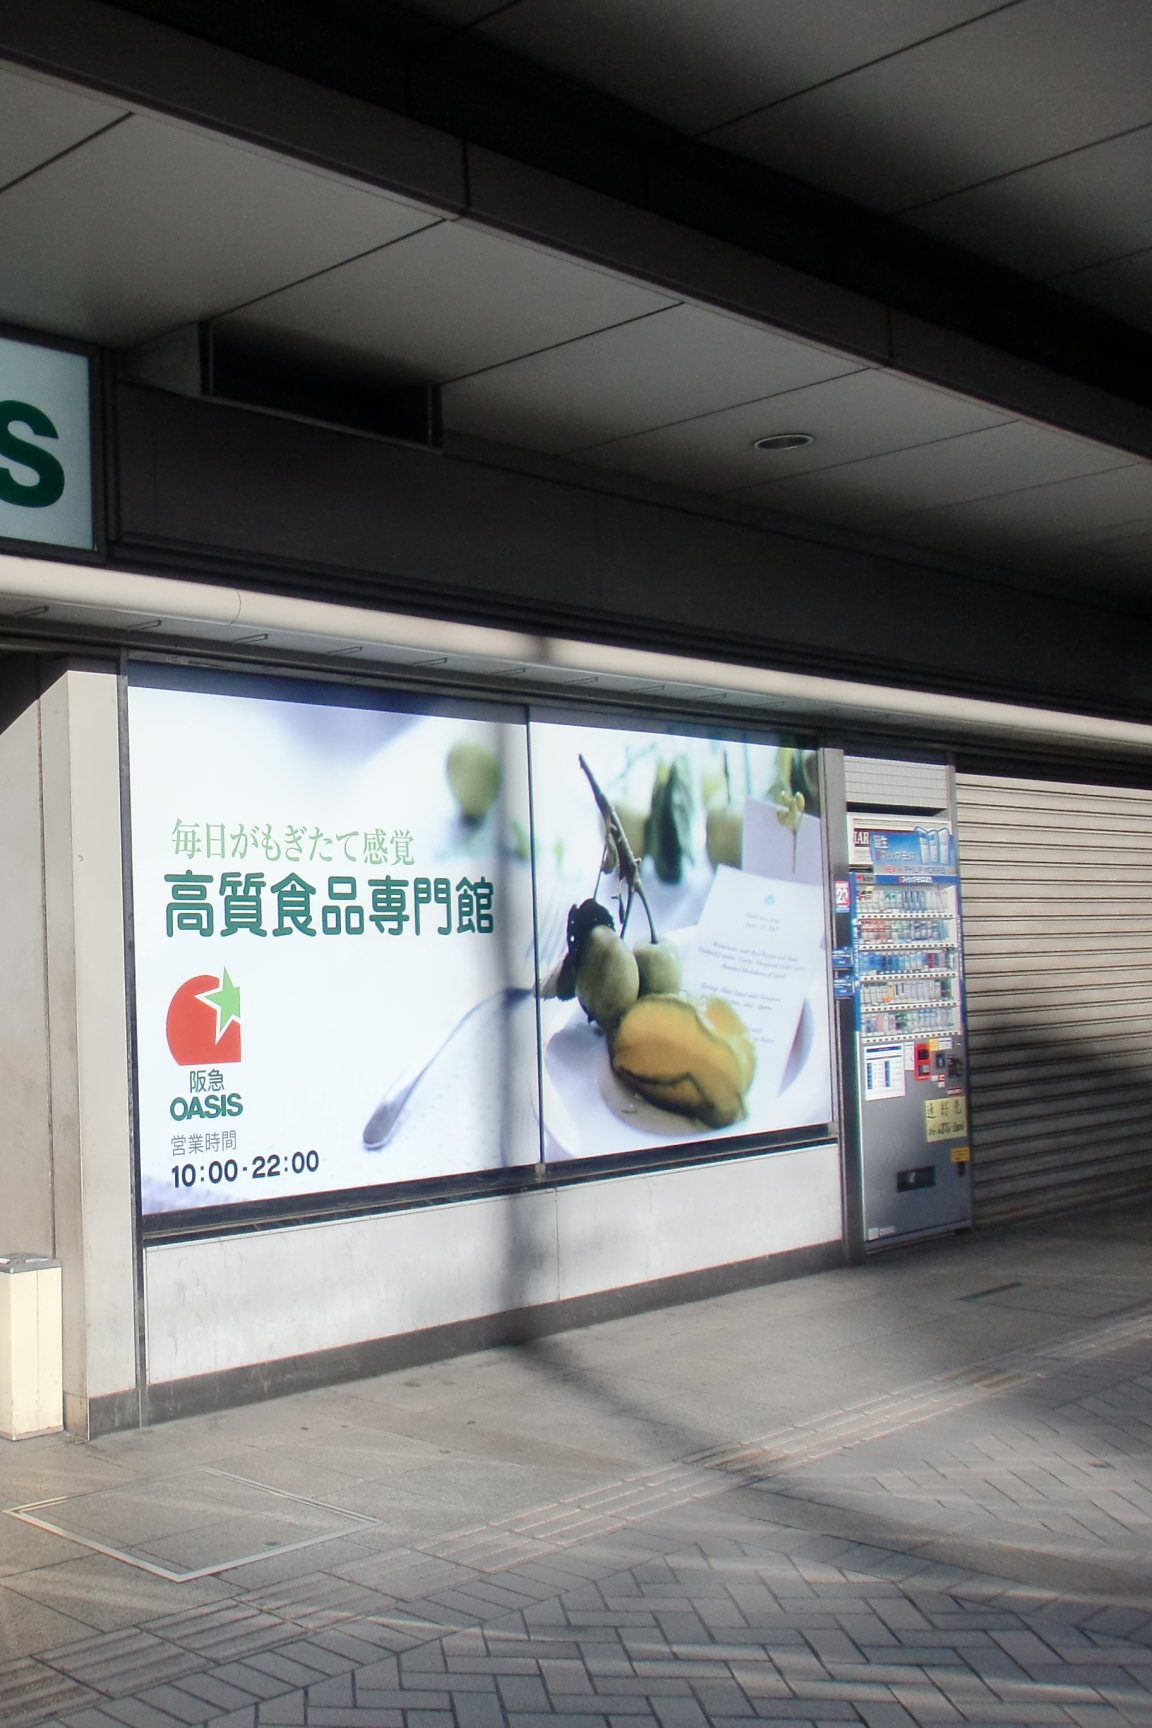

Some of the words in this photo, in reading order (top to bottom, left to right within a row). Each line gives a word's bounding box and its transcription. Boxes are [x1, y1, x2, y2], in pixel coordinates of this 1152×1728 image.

[171, 818, 415, 866] 毎日がもぎたて感覚
[163, 869, 495, 938] 高質食品専門館
[189, 1068, 225, 1093] 阪急
[169, 1092, 244, 1122] OASIS
[170, 1130, 238, 1157] 営業時間
